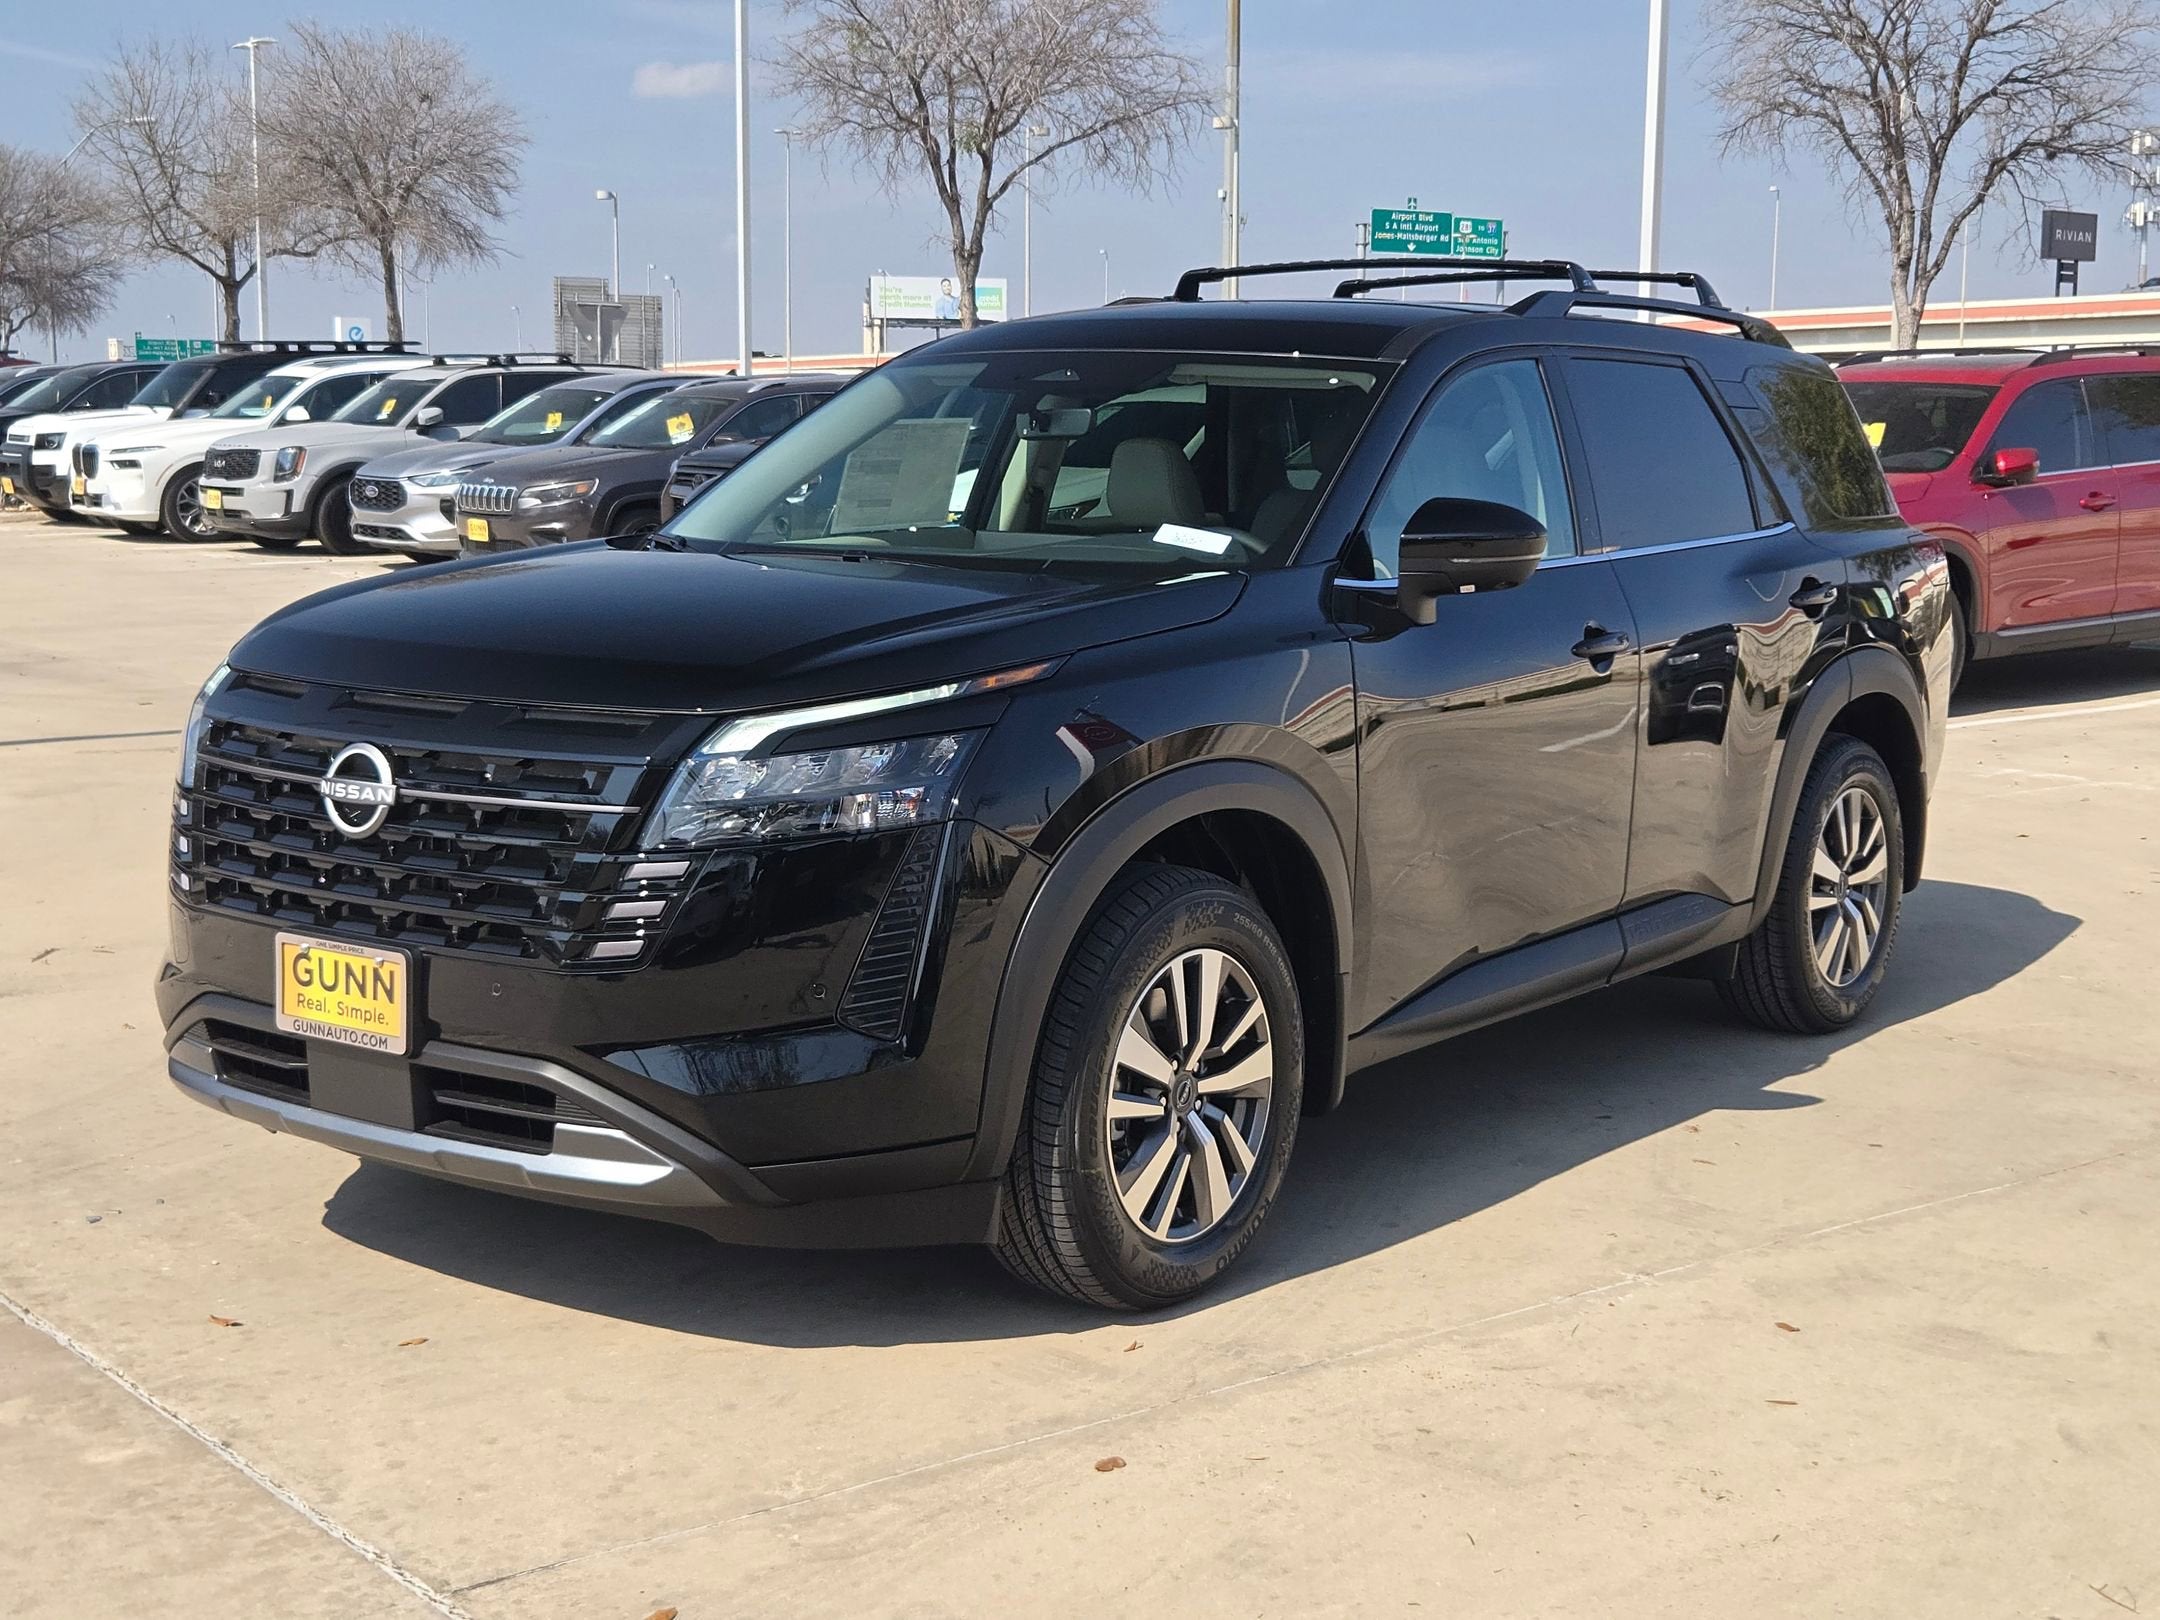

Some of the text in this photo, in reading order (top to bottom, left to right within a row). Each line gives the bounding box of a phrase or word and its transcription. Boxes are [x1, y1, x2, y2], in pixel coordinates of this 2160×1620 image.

[1391, 212, 1434, 222] Airport Blvd
[1414, 223, 1439, 232] Airport
[1374, 232, 1449, 243] Jones-Maltsberger Rd
[1472, 236, 1498, 245] Antonio
[2055, 229, 2092, 243] RIVIAN
[1486, 246, 1499, 256] City
[321, 780, 393, 803] NISSAN
[1233, 912, 1263, 938] 255/60
[316, 940, 365, 954] ONE SIMPLE PRICE
[292, 952, 395, 1004] GUNN
[297, 993, 389, 1026] Real. Simple.
[293, 1019, 388, 1050] GUNNAUTO.COM
[1216, 1197, 1272, 1272] KUMHO
